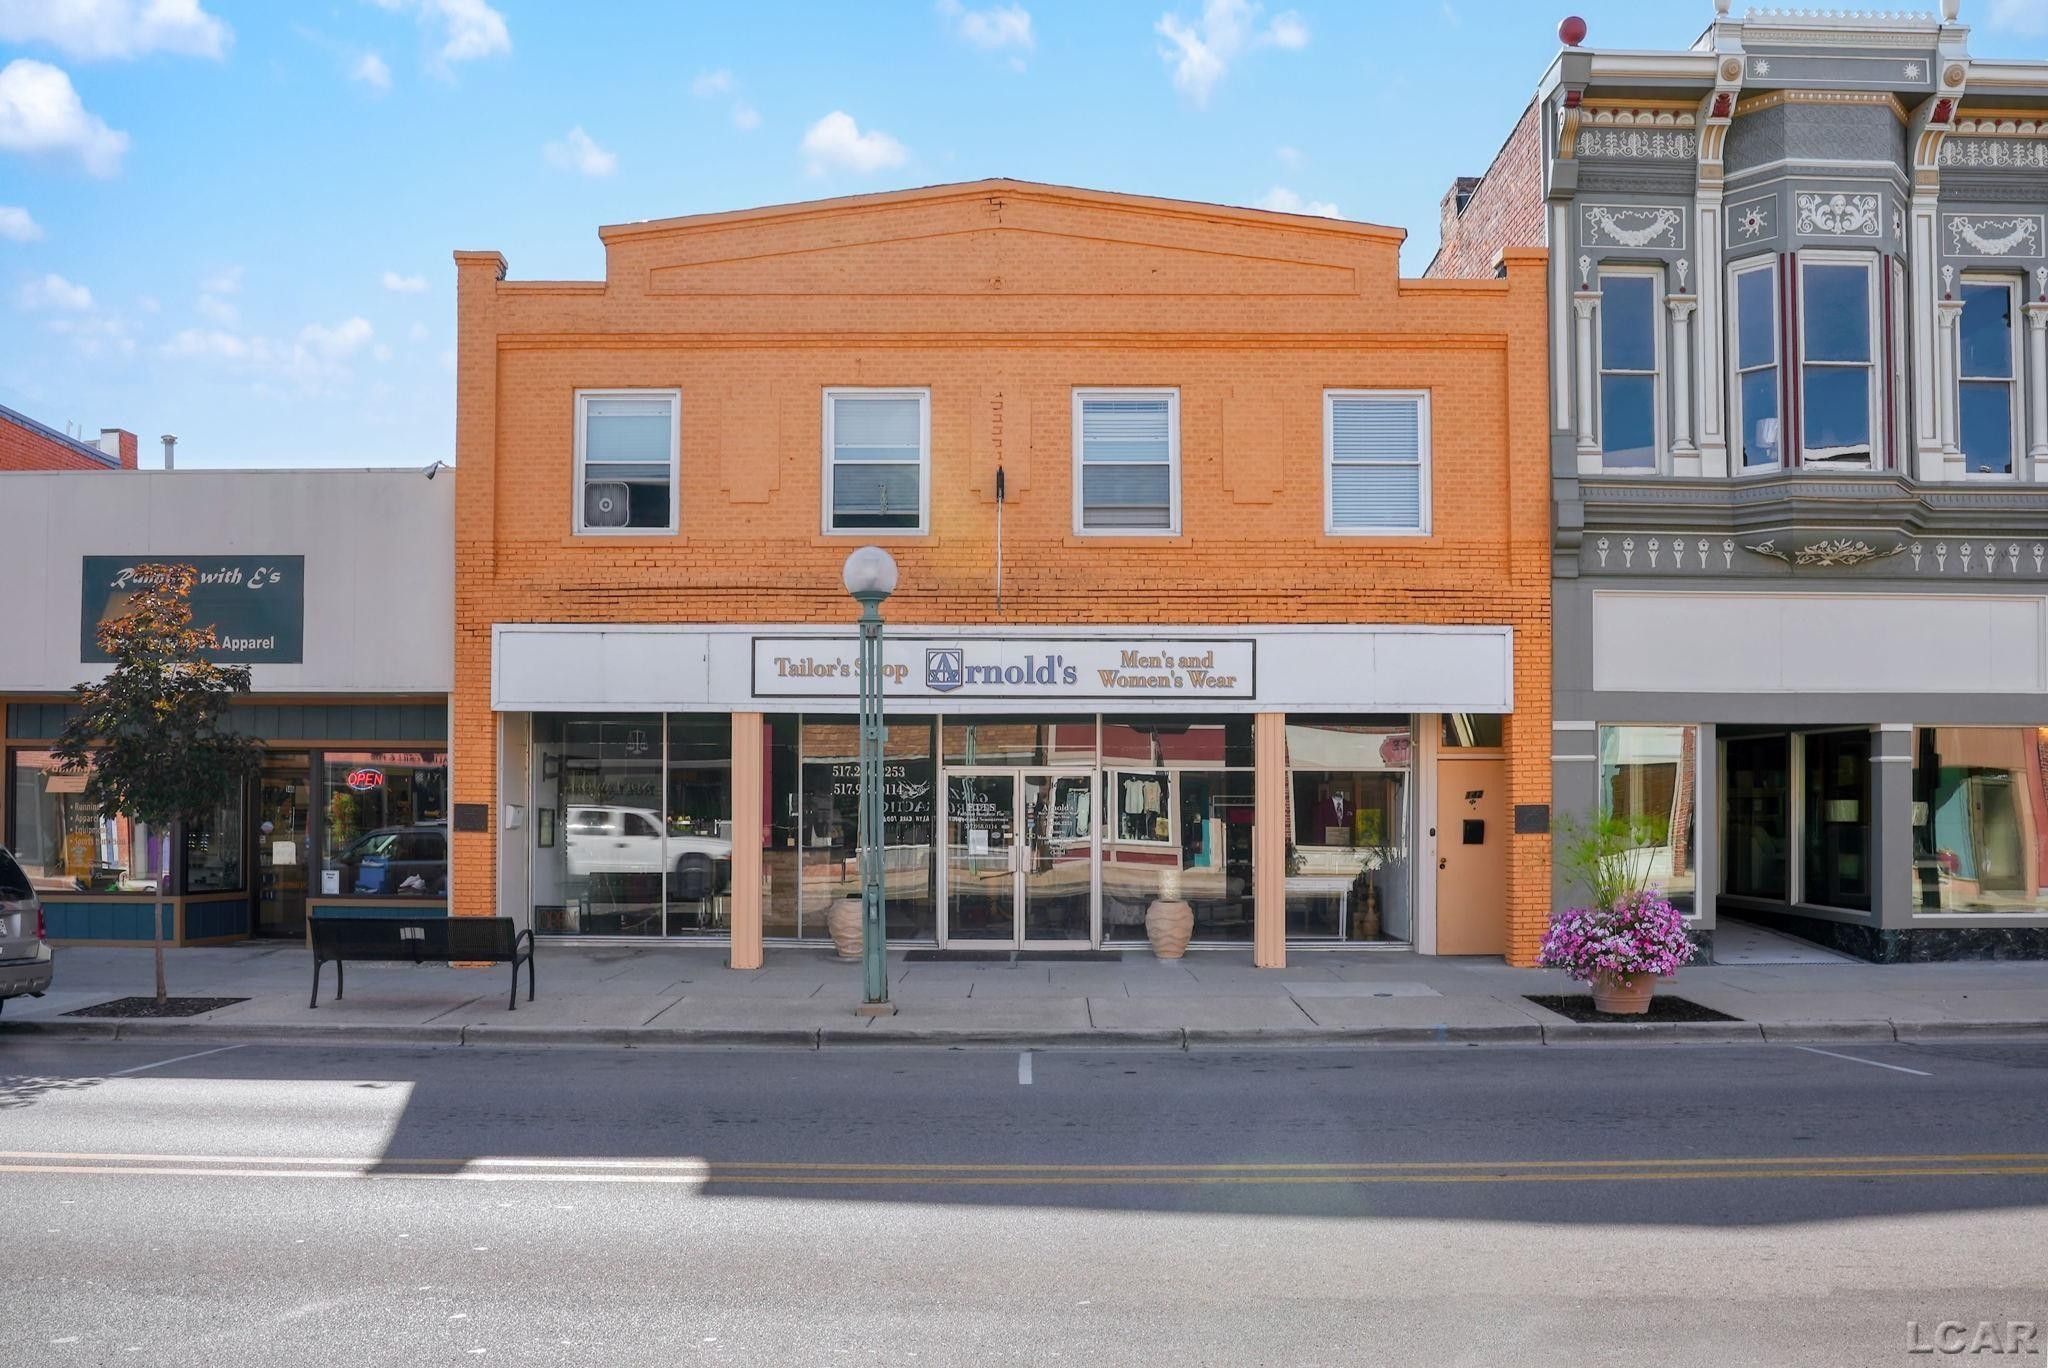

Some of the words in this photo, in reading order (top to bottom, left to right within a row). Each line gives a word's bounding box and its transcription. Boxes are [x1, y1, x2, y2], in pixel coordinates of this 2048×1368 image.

[201, 568, 242, 585] with
[247, 567, 281, 589] E's
[223, 636, 274, 652] Apparel
[1121, 650, 1173, 668] Men's
[1178, 651, 1214, 668] and
[774, 657, 850, 677] Tailor's
[855, 657, 908, 684] Sop
[928, 652, 1077, 685] Arnold's
[1097, 670, 1184, 688] Women's
[1187, 670, 1237, 688] Wear
[347, 772, 384, 786] OPEN
